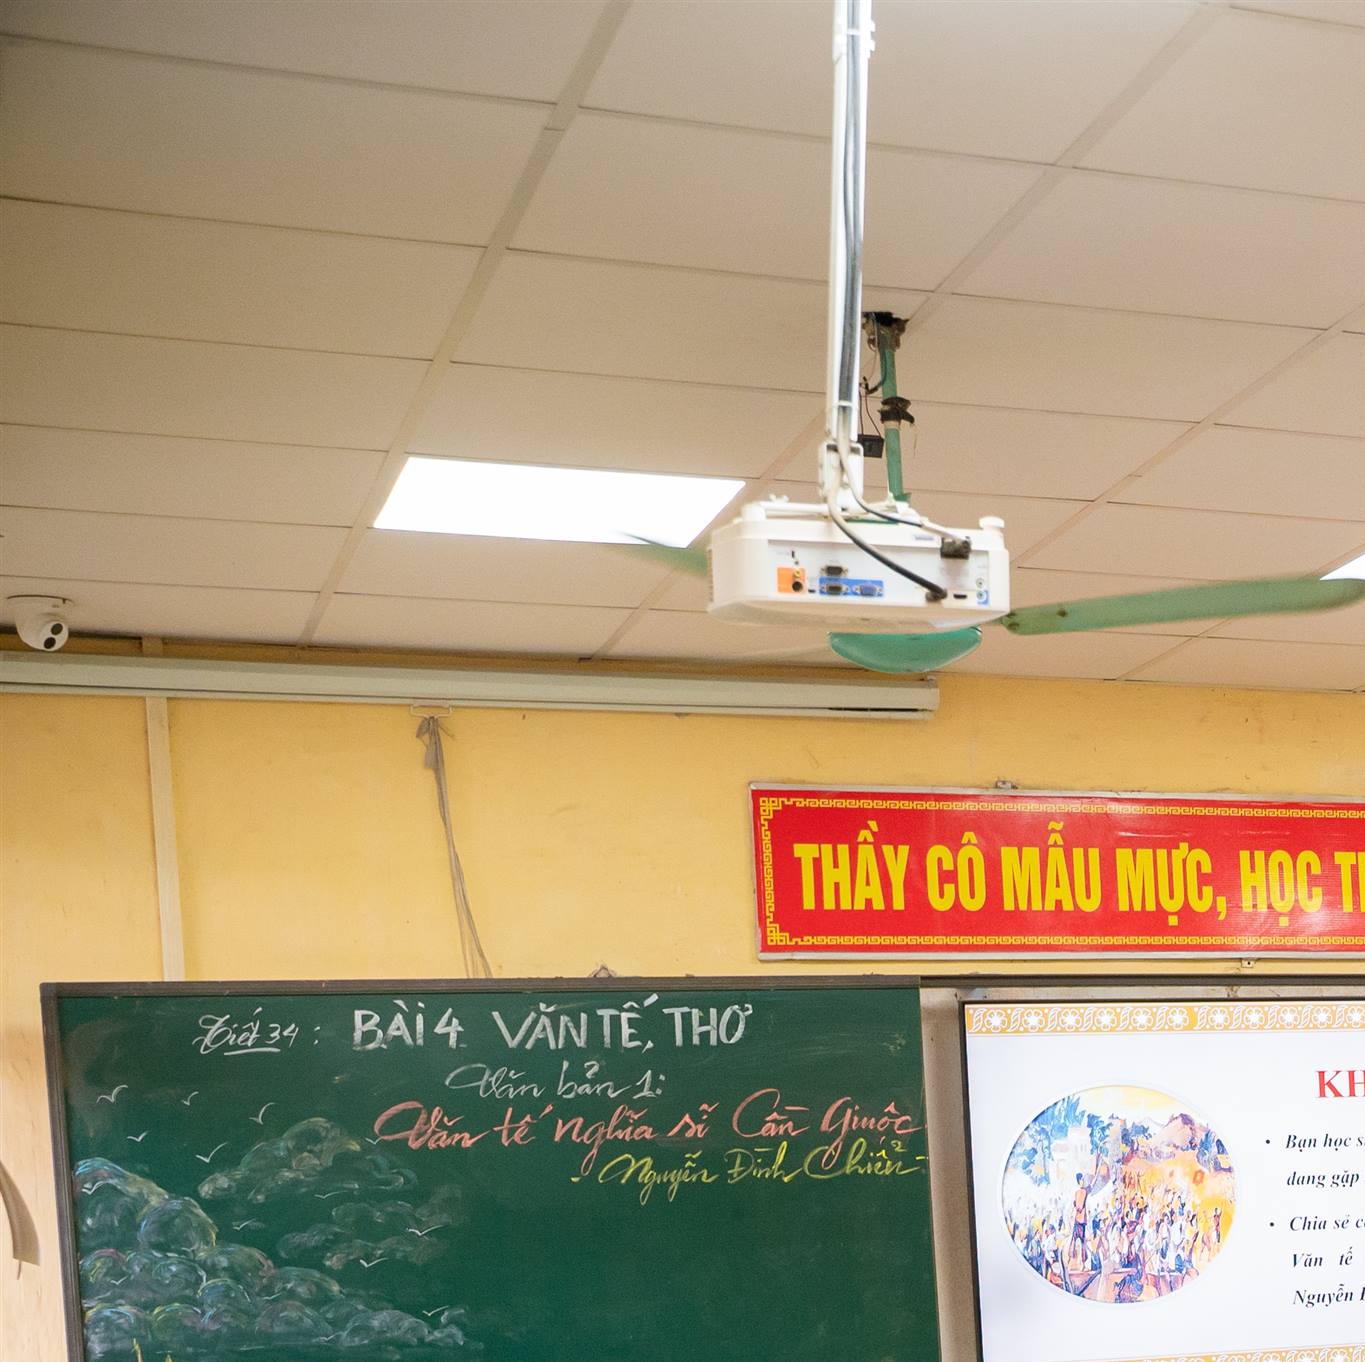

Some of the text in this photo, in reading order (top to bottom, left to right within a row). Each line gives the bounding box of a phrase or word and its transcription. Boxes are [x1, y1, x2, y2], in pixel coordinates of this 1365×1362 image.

[793, 825, 908, 912] THẦY
[925, 831, 987, 912] CÔ
[1000, 820, 1102, 913] MẪU
[1115, 841, 1228, 927] MỰC,
[1238, 849, 1323, 925] HỌC
[434, 1007, 465, 1049] 4
[491, 1002, 588, 1050] VĂN
[662, 1003, 753, 1047] THƠ
[1285, 1134, 1317, 1153] Bạn
[1323, 1133, 1352, 1152] học
[1329, 1170, 1360, 1188] gặp
[1289, 1215, 1327, 1232] Chia
[1292, 1253, 1323, 1268] Văn
[1339, 1246, 1353, 1266] tế
[1293, 1283, 1354, 1308] Nguyễn
